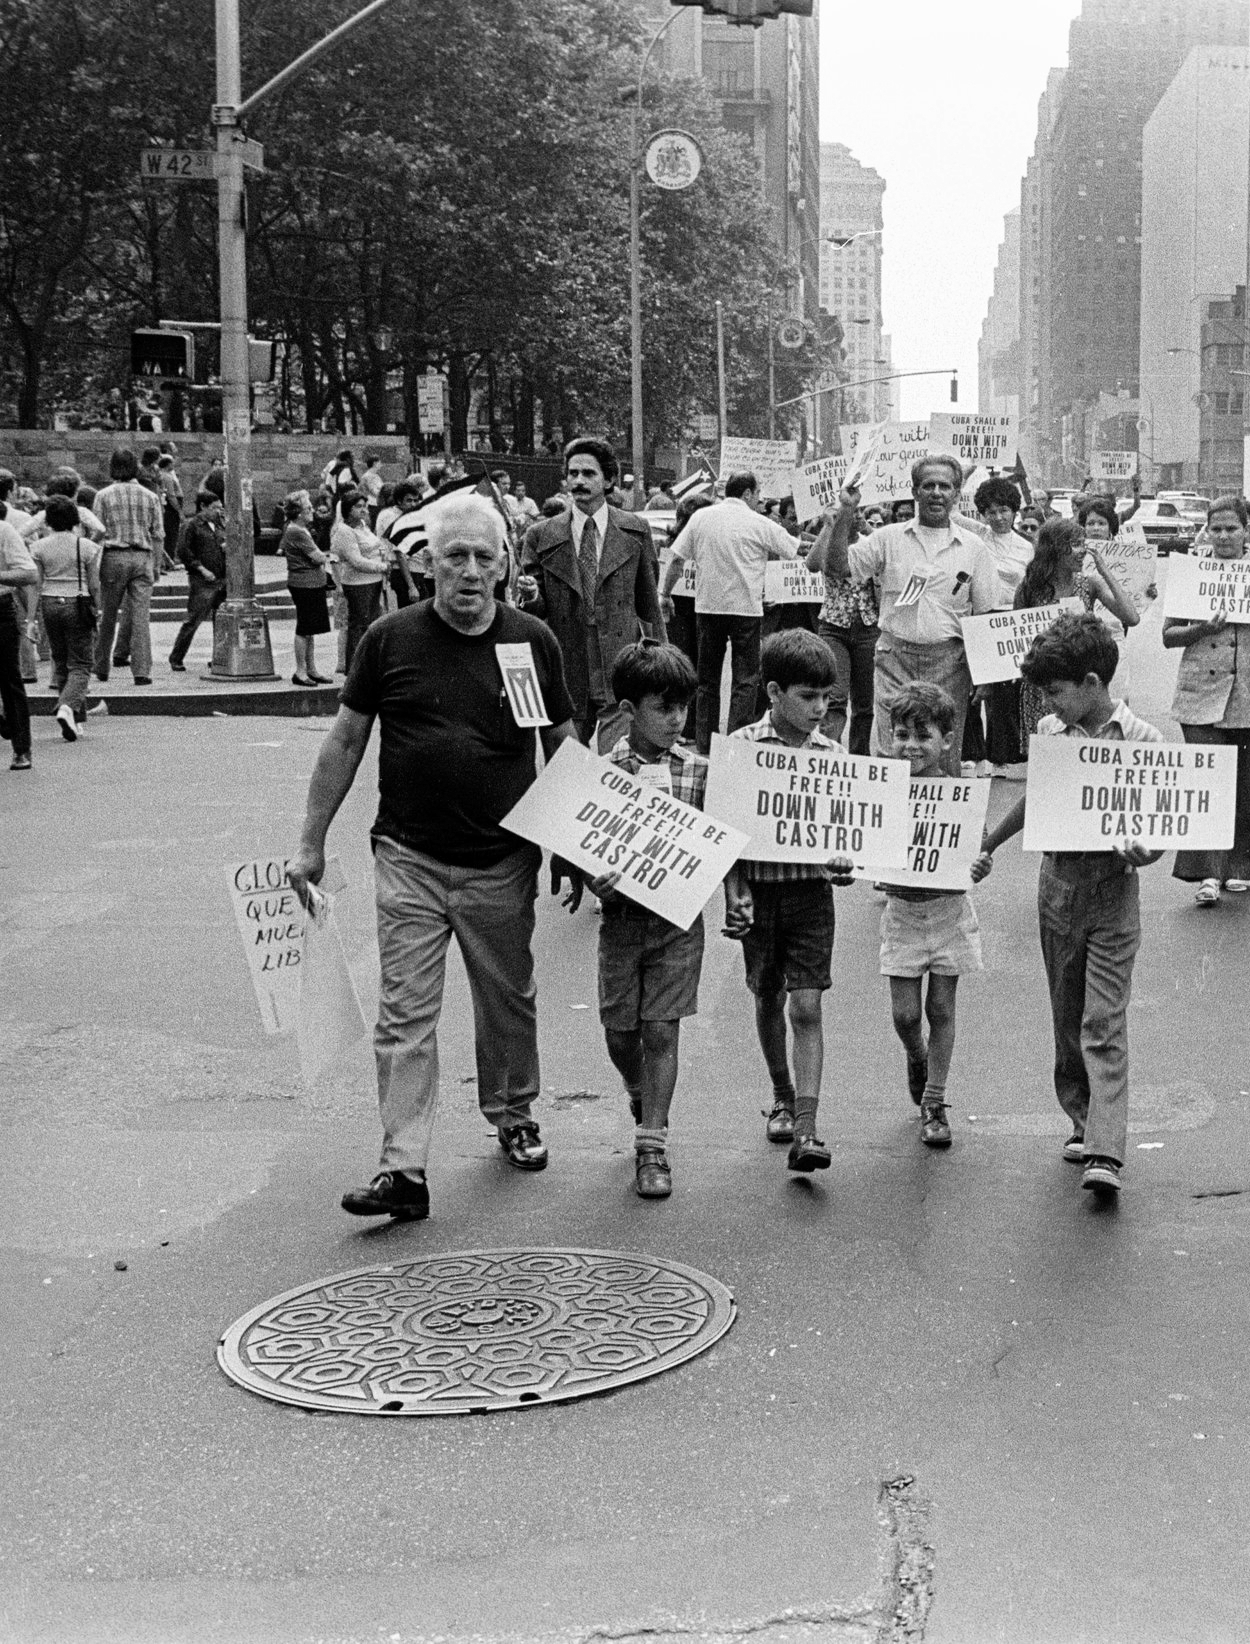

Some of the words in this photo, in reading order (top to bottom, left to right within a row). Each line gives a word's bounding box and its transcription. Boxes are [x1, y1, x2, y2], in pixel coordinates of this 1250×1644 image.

[147, 154, 161, 173] W
[167, 154, 192, 175] 42
[196, 155, 208, 166] ST
[951, 416, 971, 426] CUBA
[974, 417, 998, 426] SHALL
[1001, 418, 1010, 426] BE
[966, 425, 994, 434] FREE!!
[900, 425, 930, 442] with
[952, 434, 978, 447] DOWN
[983, 435, 1007, 447] WITH
[960, 447, 999, 460] CASTRO
[805, 464, 821, 476] CUBA
[824, 459, 848, 470] SHALL
[819, 467, 847, 480] FREE!!
[810, 479, 833, 497] DOWN
[819, 491, 836, 506] CAS
[782, 562, 798, 570] CUBA
[1199, 561, 1225, 572] CUBA
[784, 577, 806, 587] DOWN
[791, 586, 824, 597] CASTRO
[1200, 582, 1236, 597] DOWN
[989, 616, 1016, 629] CUBA
[1021, 610, 1053, 624] SHALL
[997, 637, 1033, 657] DOWN
[756, 751, 798, 772] CUBA
[808, 757, 858, 779] SHALL
[868, 765, 889, 783] BE
[1079, 746, 1123, 766] CUBA
[1132, 749, 1184, 768] SHALL
[1195, 752, 1216, 769] BE
[789, 775, 852, 798] FREE!!
[1114, 768, 1178, 787] FREE!!
[909, 784, 944, 801] HALL
[952, 786, 971, 802] BE
[1081, 785, 1142, 812] DOWN
[1155, 788, 1210, 813] WITH
[601, 771, 642, 801] CUBA
[647, 796, 697, 830] SHALL
[703, 825, 728, 846] BE
[757, 790, 817, 822] DOWN
[830, 799, 883, 829] WITH
[621, 803, 682, 841] FREE!!
[1101, 813, 1190, 836] CASTRO
[576, 801, 642, 844] DOWN
[642, 835, 702, 879] WITH
[775, 820, 863, 852] CASTRO
[912, 822, 962, 848] WITH
[580, 830, 668, 890] CASTRO
[907, 846, 940, 873] TRO
[246, 896, 293, 922] QUE
